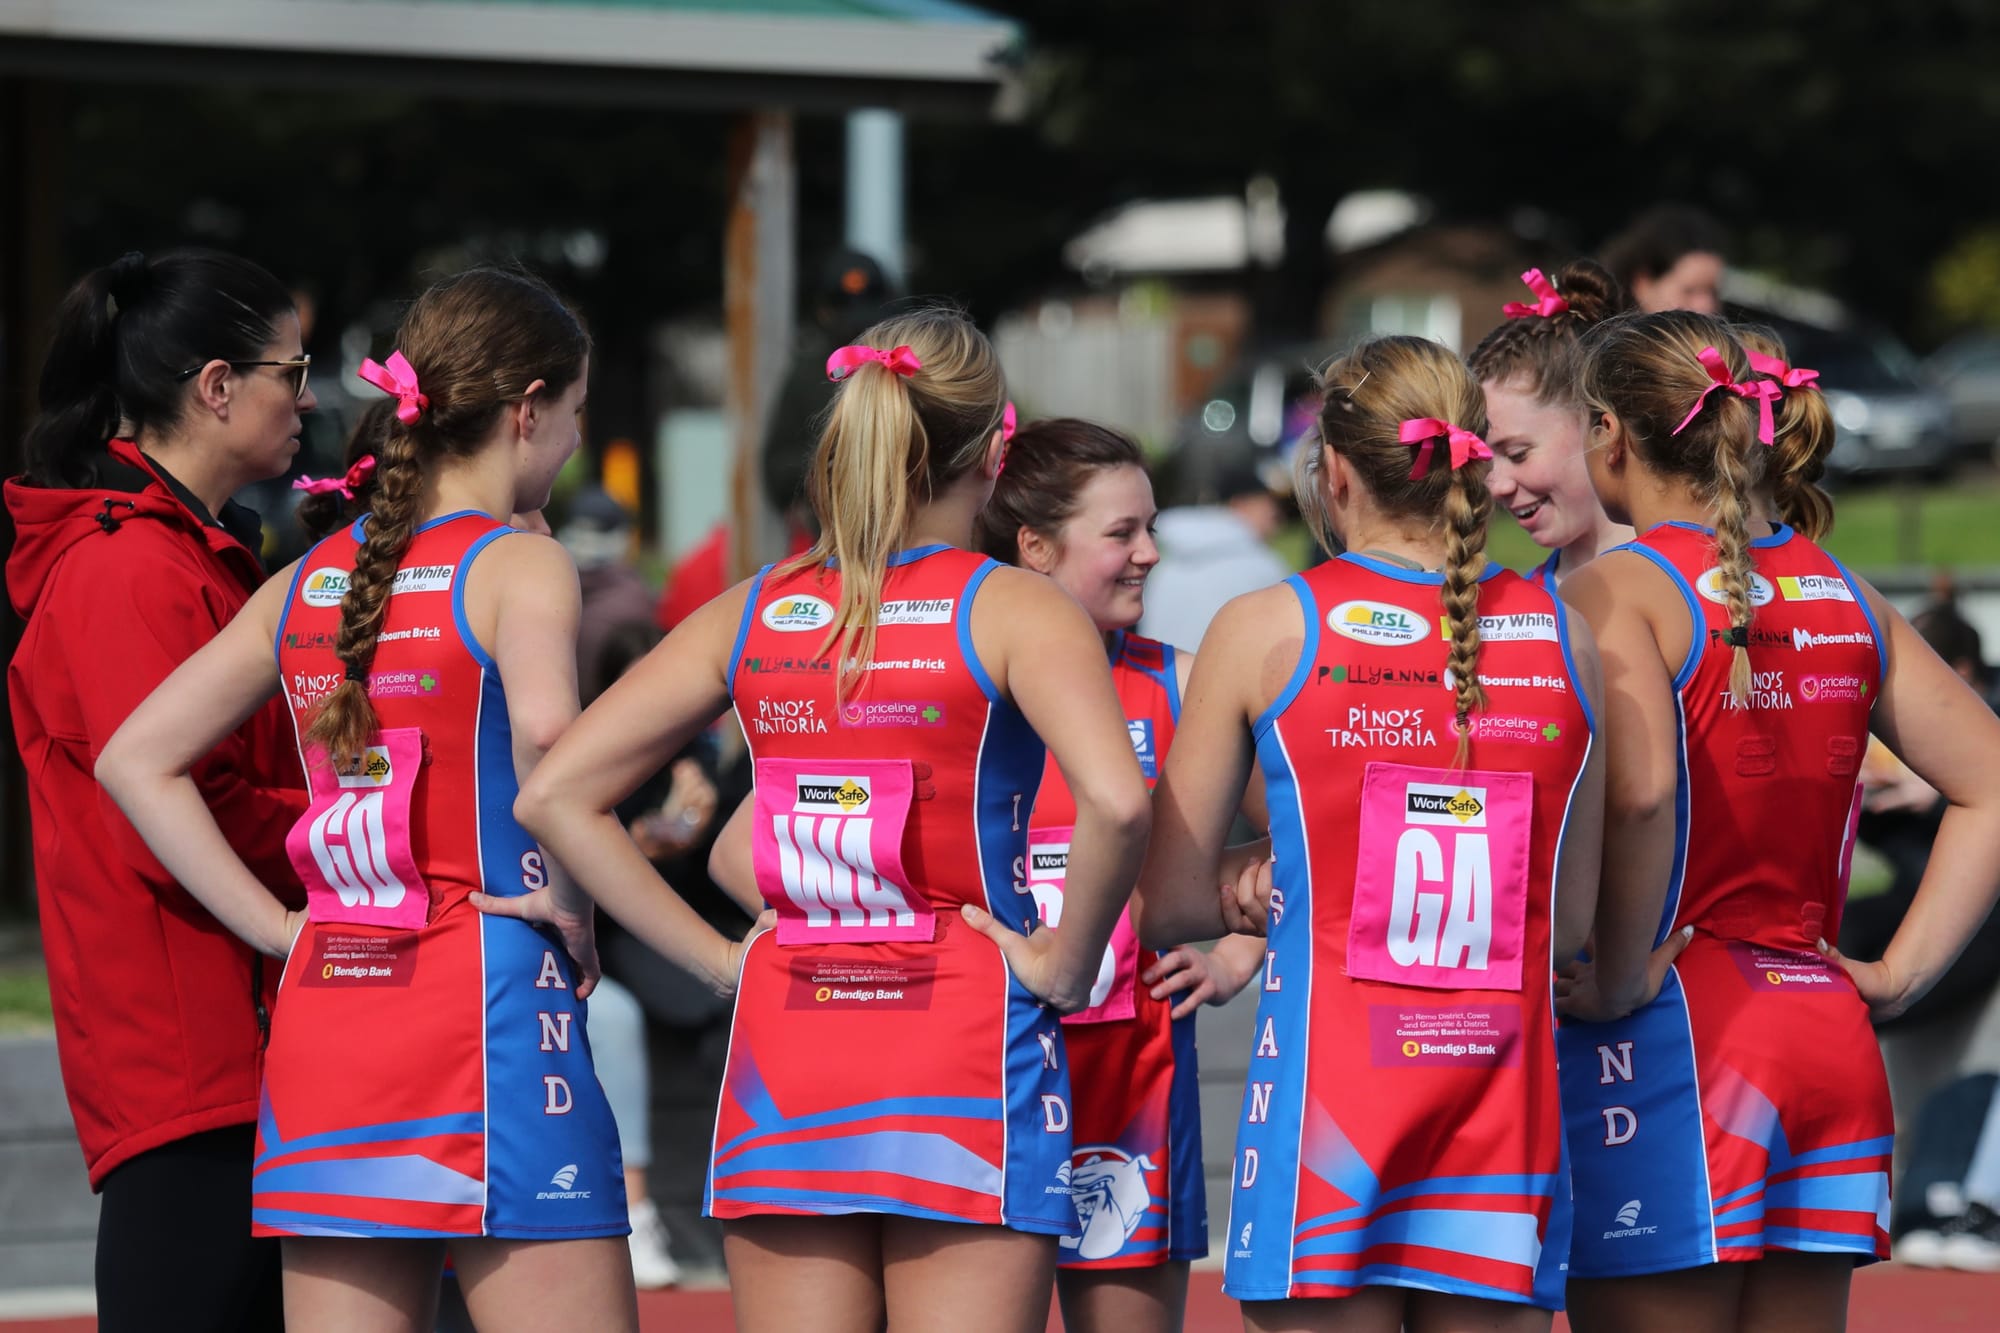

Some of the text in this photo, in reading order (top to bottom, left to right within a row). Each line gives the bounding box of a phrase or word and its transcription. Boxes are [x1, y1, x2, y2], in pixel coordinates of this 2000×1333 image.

[321, 575, 346, 589] RSL
[394, 571, 410, 584] ay
[1799, 576, 1822, 589] Ray
[790, 602, 820, 616] RSL
[1371, 611, 1411, 628] RSL
[412, 627, 440, 638] Brick
[1352, 628, 1412, 640] PHILLIP ISLAND
[1480, 631, 1534, 640] HILLIP ISLAND
[1793, 627, 1873, 651] Melbourne Brick
[912, 658, 946, 670] Brick
[377, 673, 416, 686] priceline
[1532, 675, 1566, 690] Brick
[1753, 671, 1783, 690] NO'S
[1821, 676, 1859, 689] priceline
[377, 684, 418, 695] pharmacy
[1821, 687, 1858, 700] pharmacy
[866, 703, 917, 715] priceline
[866, 714, 918, 726] pharmacy
[1479, 716, 1538, 730] priceline
[1478, 729, 1537, 743] pharmacy
[1037, 856, 1067, 867] Work
[773, 814, 915, 927] WA
[1387, 828, 1492, 970] GA
[334, 966, 392, 978] Bendigo Bank
[832, 989, 904, 1001] Bendigo Bank
[1396, 1029, 1439, 1037] Community
[1467, 1028, 1499, 1036] branches
[1421, 1043, 1496, 1056] Bendigo Bank
[536, 1191, 591, 1200] ENERGETIC
[1603, 1226, 1658, 1239] ENERGETIC
